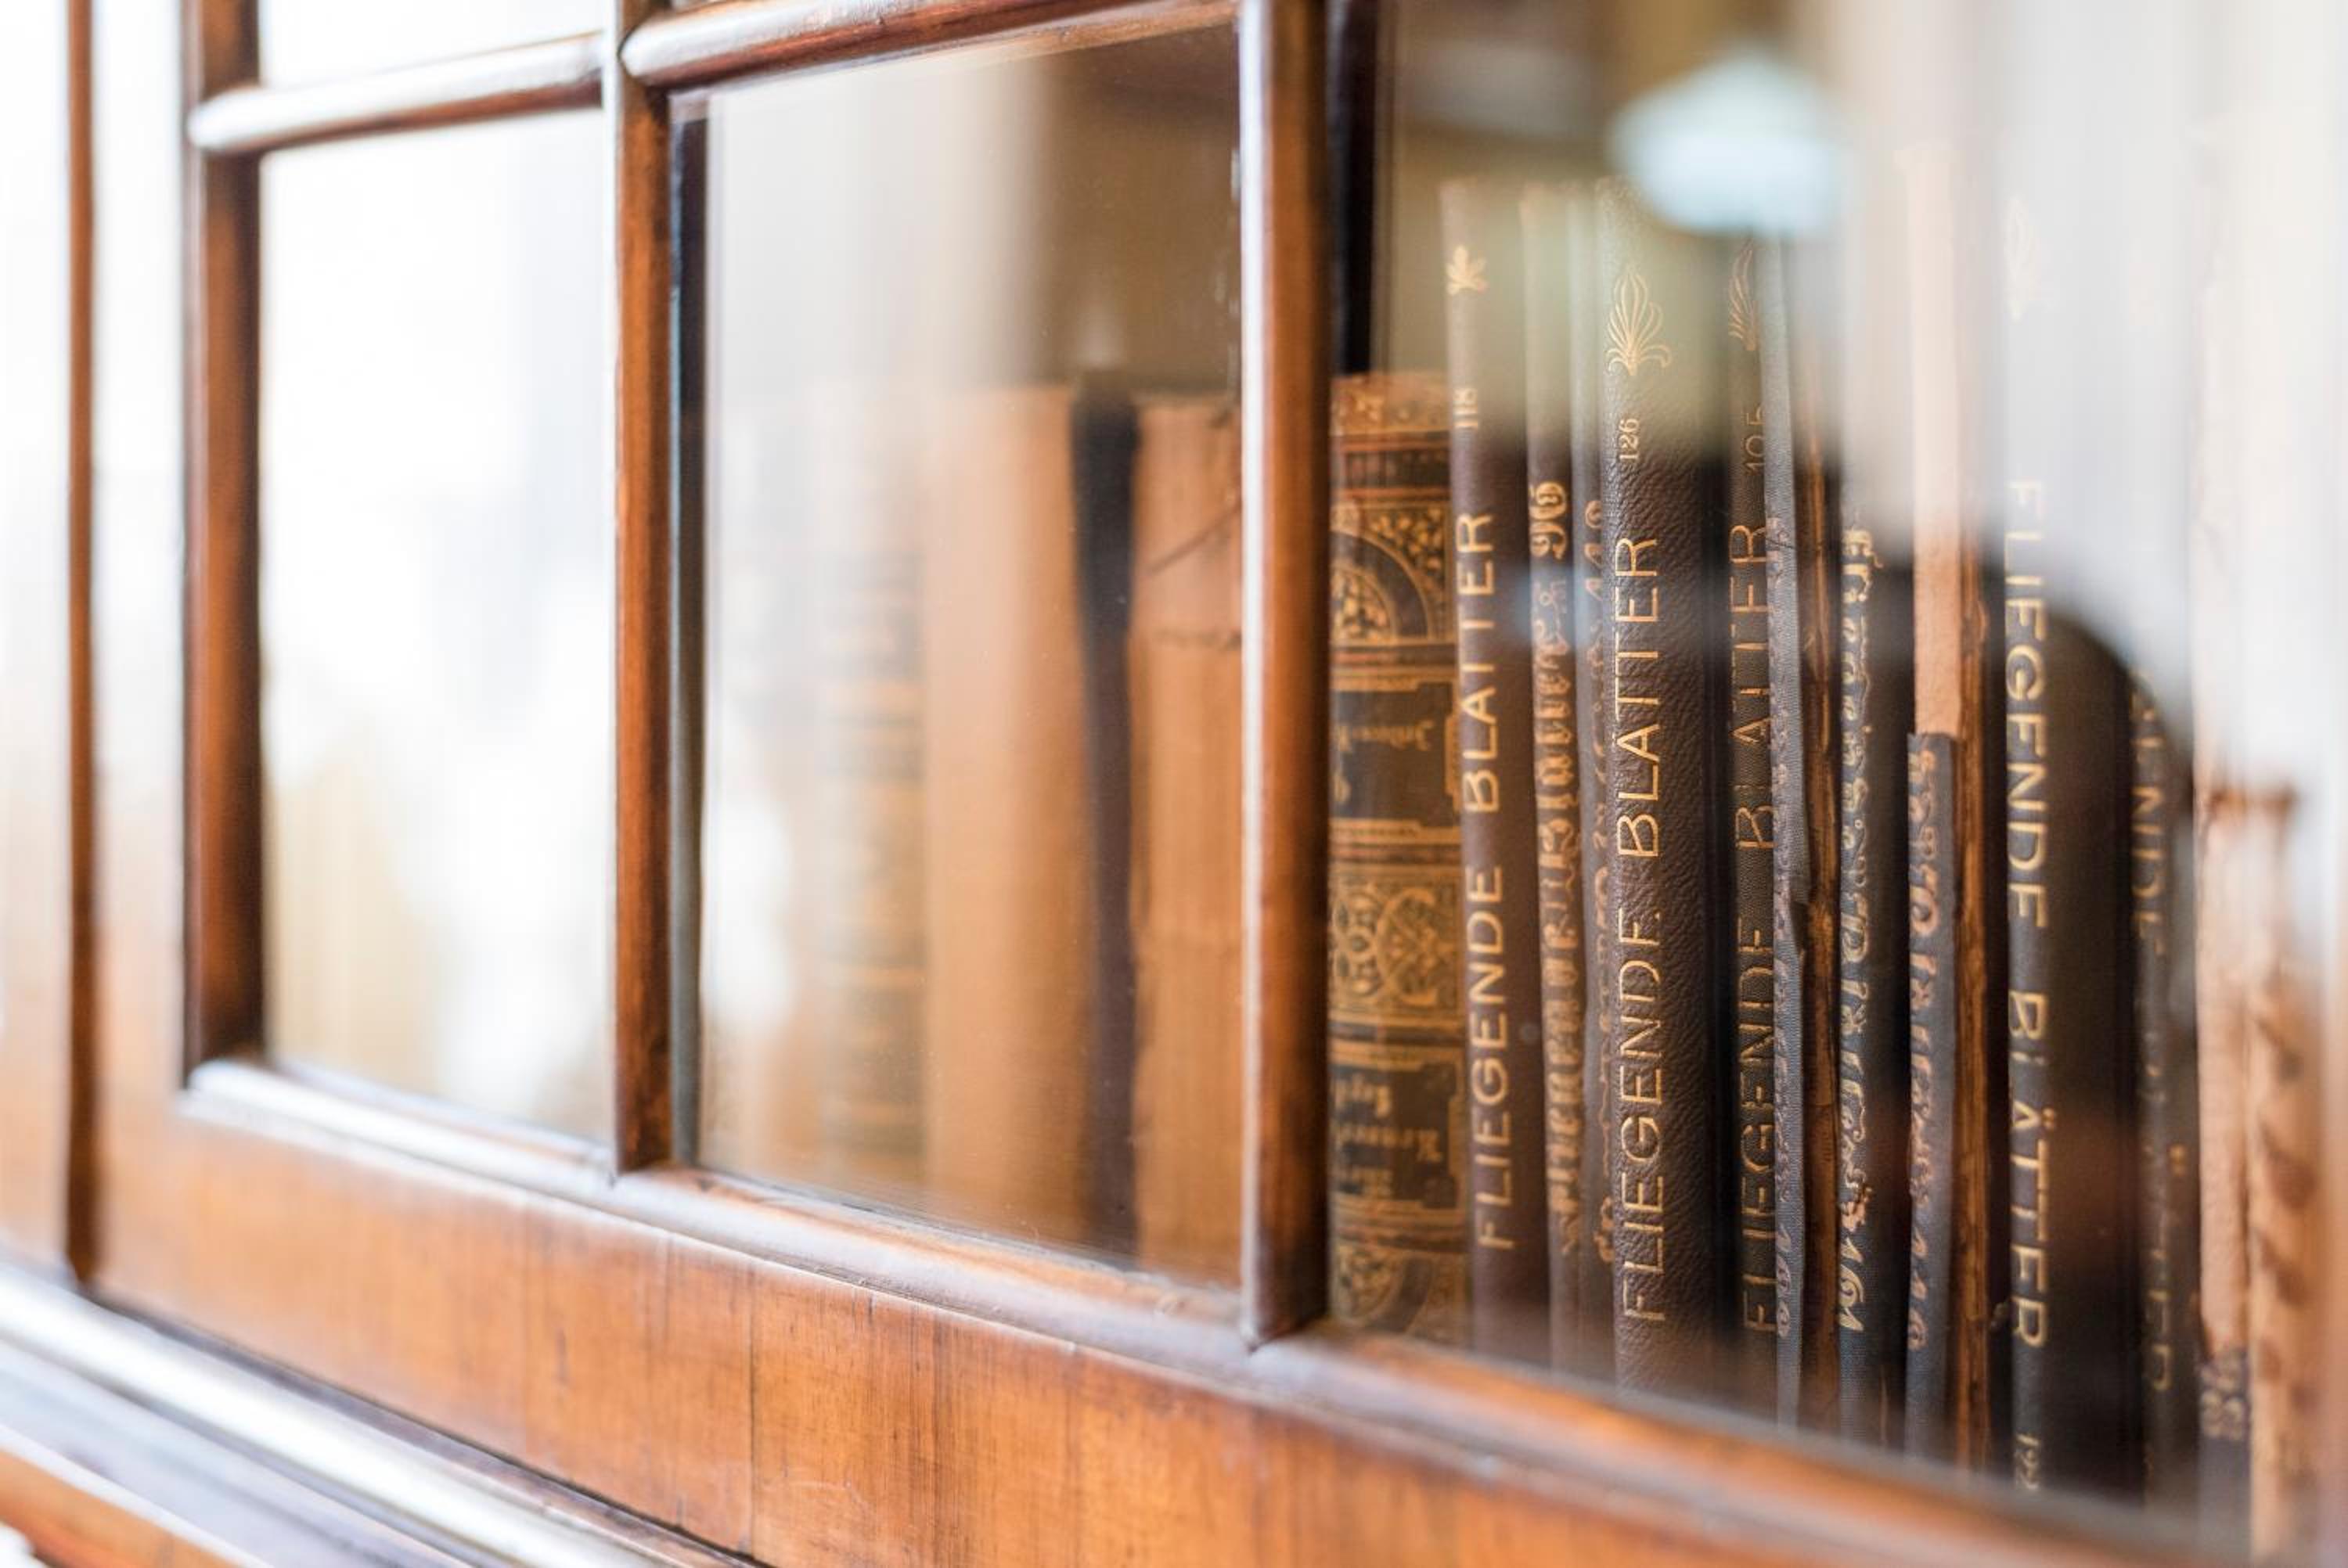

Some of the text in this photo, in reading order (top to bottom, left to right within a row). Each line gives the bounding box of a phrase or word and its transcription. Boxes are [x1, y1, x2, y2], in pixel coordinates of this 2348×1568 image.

[1619, 417, 1640, 462] 126
[1467, 865, 1515, 1250] FLIEGENDE
[1617, 908, 1666, 1322] FLIEGENDE
